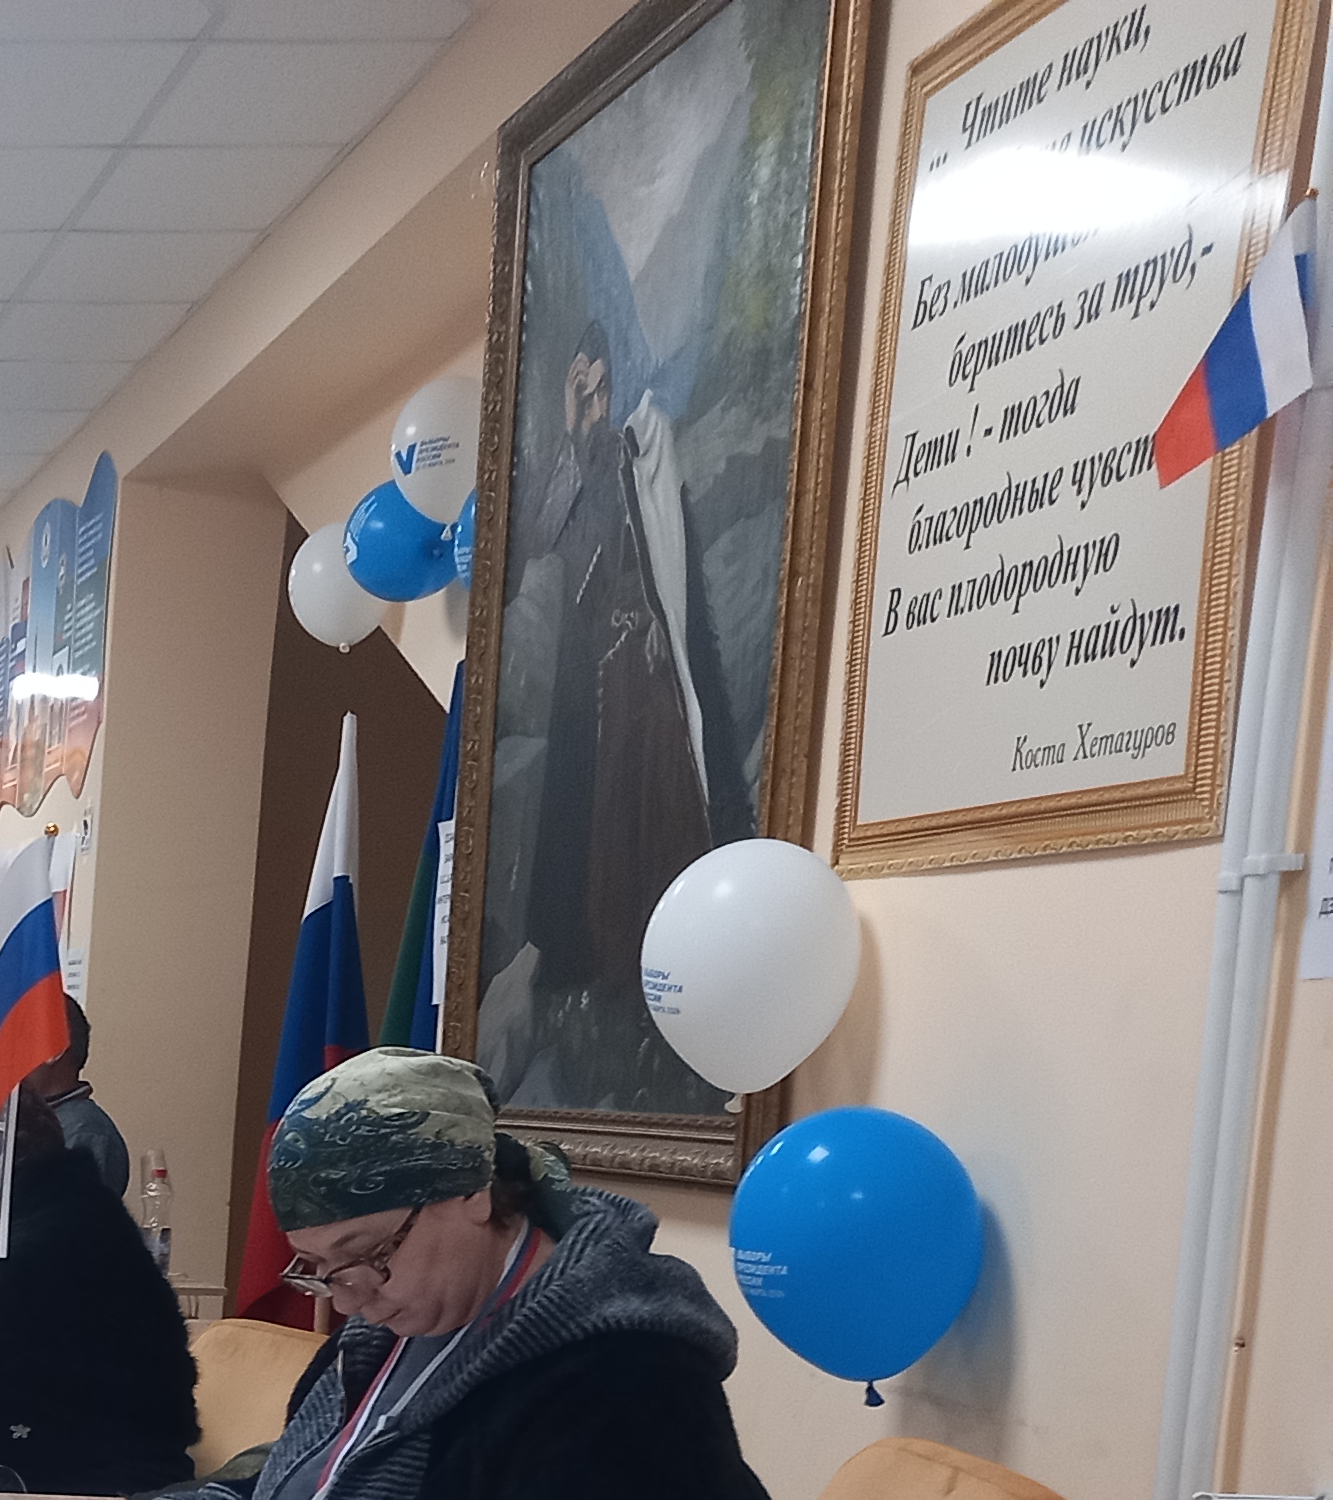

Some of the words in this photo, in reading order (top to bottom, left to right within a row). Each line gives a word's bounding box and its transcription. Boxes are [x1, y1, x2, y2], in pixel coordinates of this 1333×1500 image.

[961, 62, 1054, 151] Чтите
[1058, 3, 1152, 91] науки,
[1078, 30, 1248, 159] искусства
[911, 274, 952, 332] Без
[948, 298, 1068, 395] беритесь
[1073, 288, 1103, 332] за
[890, 431, 961, 497] Дети
[997, 367, 1082, 445] тогда
[907, 469, 1062, 556] благородные
[1071, 429, 1155, 511] чувст
[882, 586, 903, 638] В
[905, 586, 943, 631] вас
[947, 530, 1121, 618] плодородную
[985, 627, 1058, 688] почву
[1065, 597, 1187, 669] найдут.
[1011, 734, 1066, 773] Коста
[1072, 720, 1178, 764] Хетагуров
